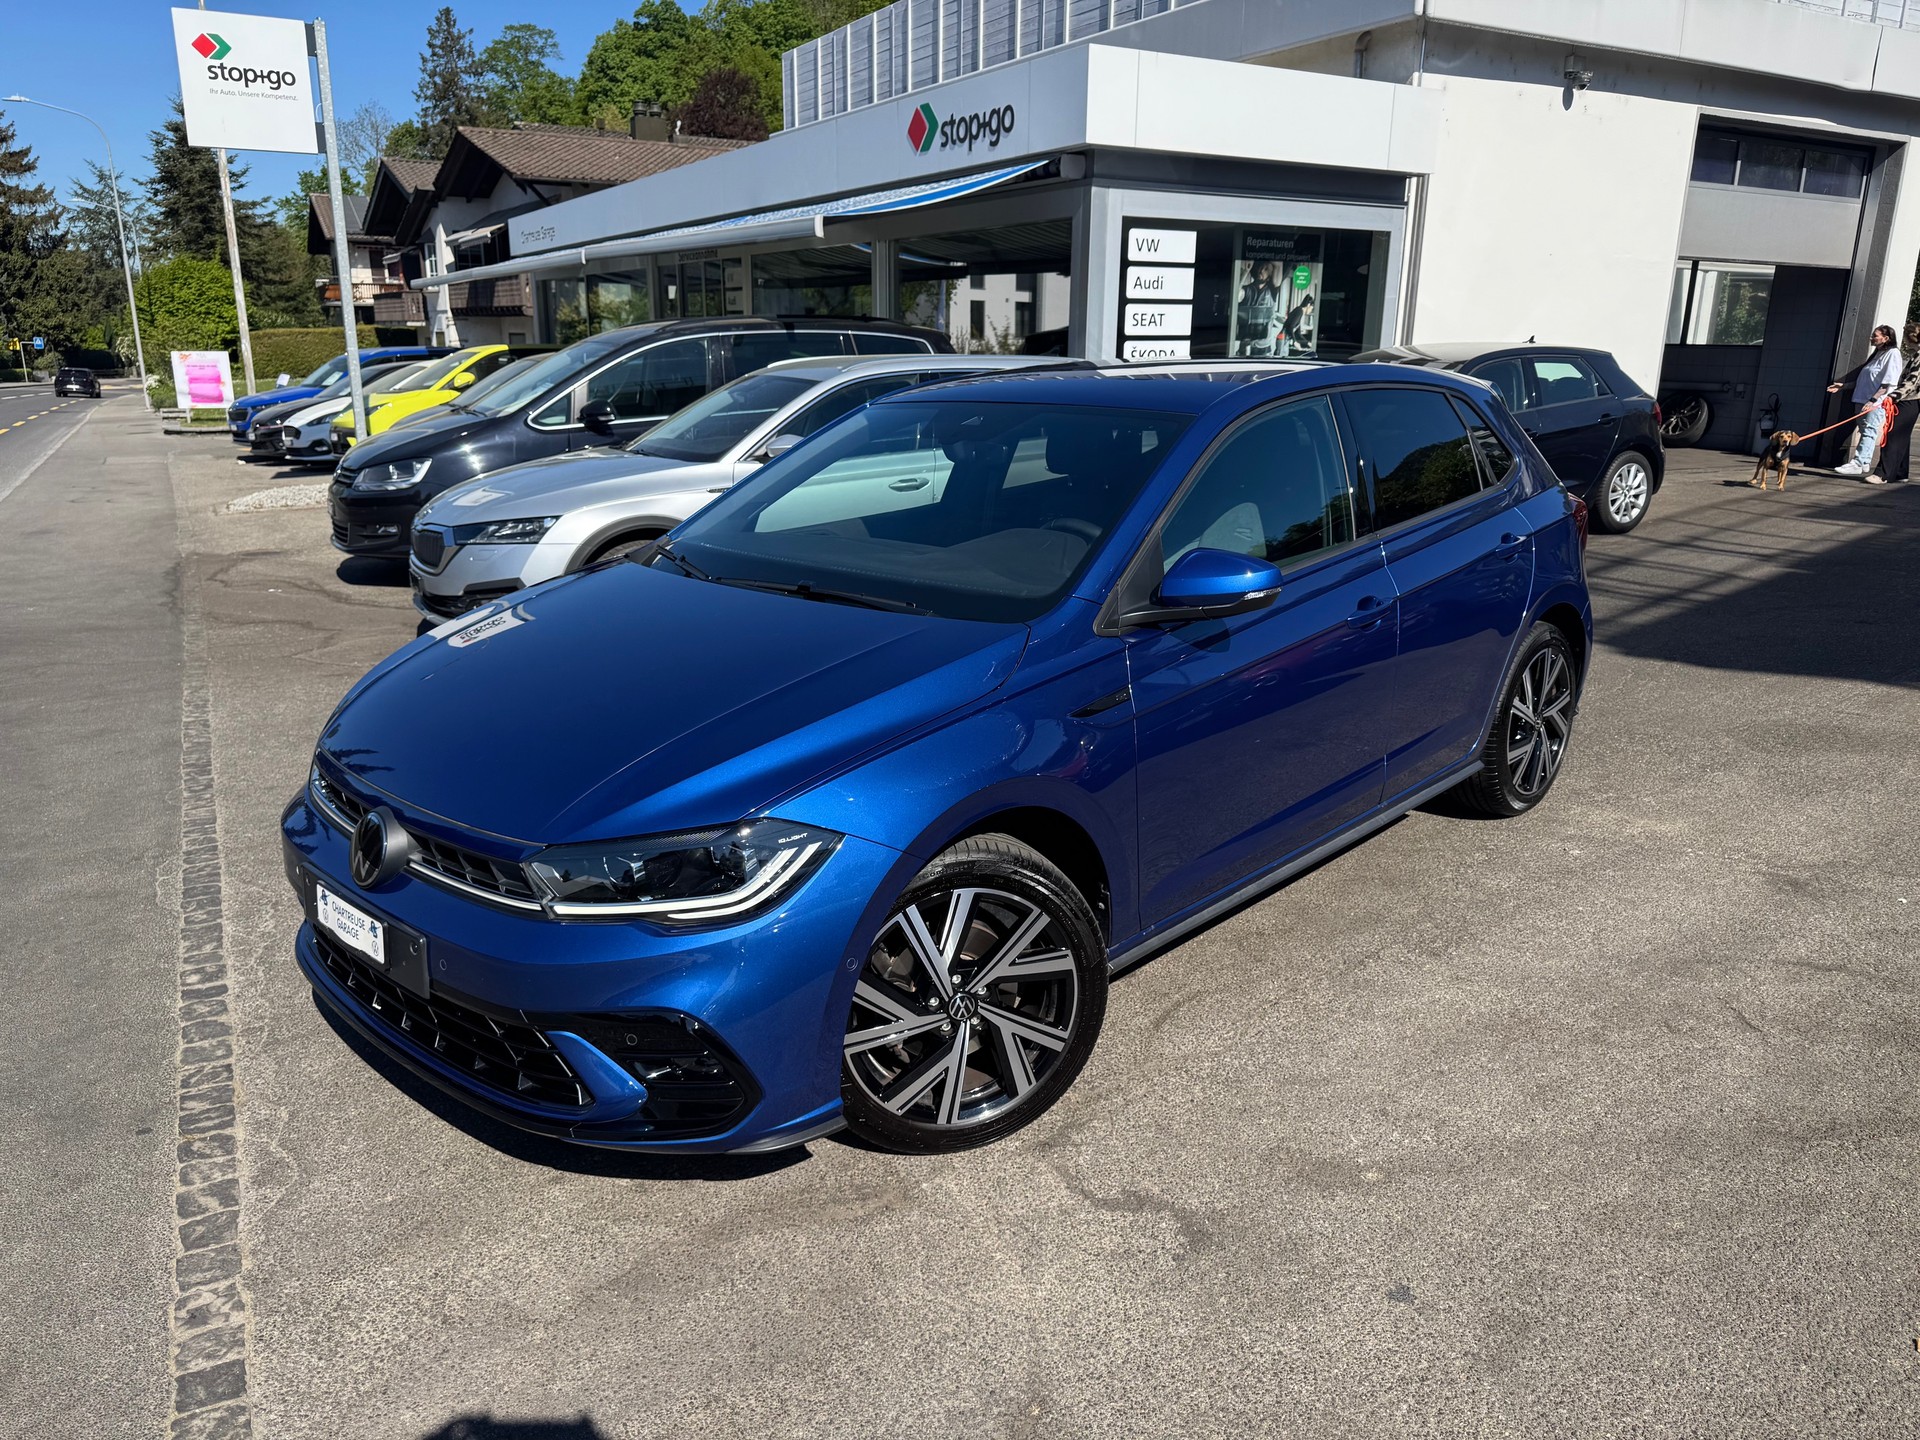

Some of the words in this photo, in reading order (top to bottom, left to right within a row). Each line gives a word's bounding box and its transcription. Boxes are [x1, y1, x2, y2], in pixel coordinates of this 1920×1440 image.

[207, 62, 296, 91] stop+go
[238, 90, 260, 98] Unsere
[940, 104, 1015, 152] stop+go
[1135, 238, 1160, 252] VW
[1246, 236, 1294, 248] Reparaturen
[1133, 276, 1164, 290] Audi
[1132, 313, 1165, 327] SEAT
[332, 901, 366, 931] CHARTREUSE
[336, 918, 360, 941] GARAGE
